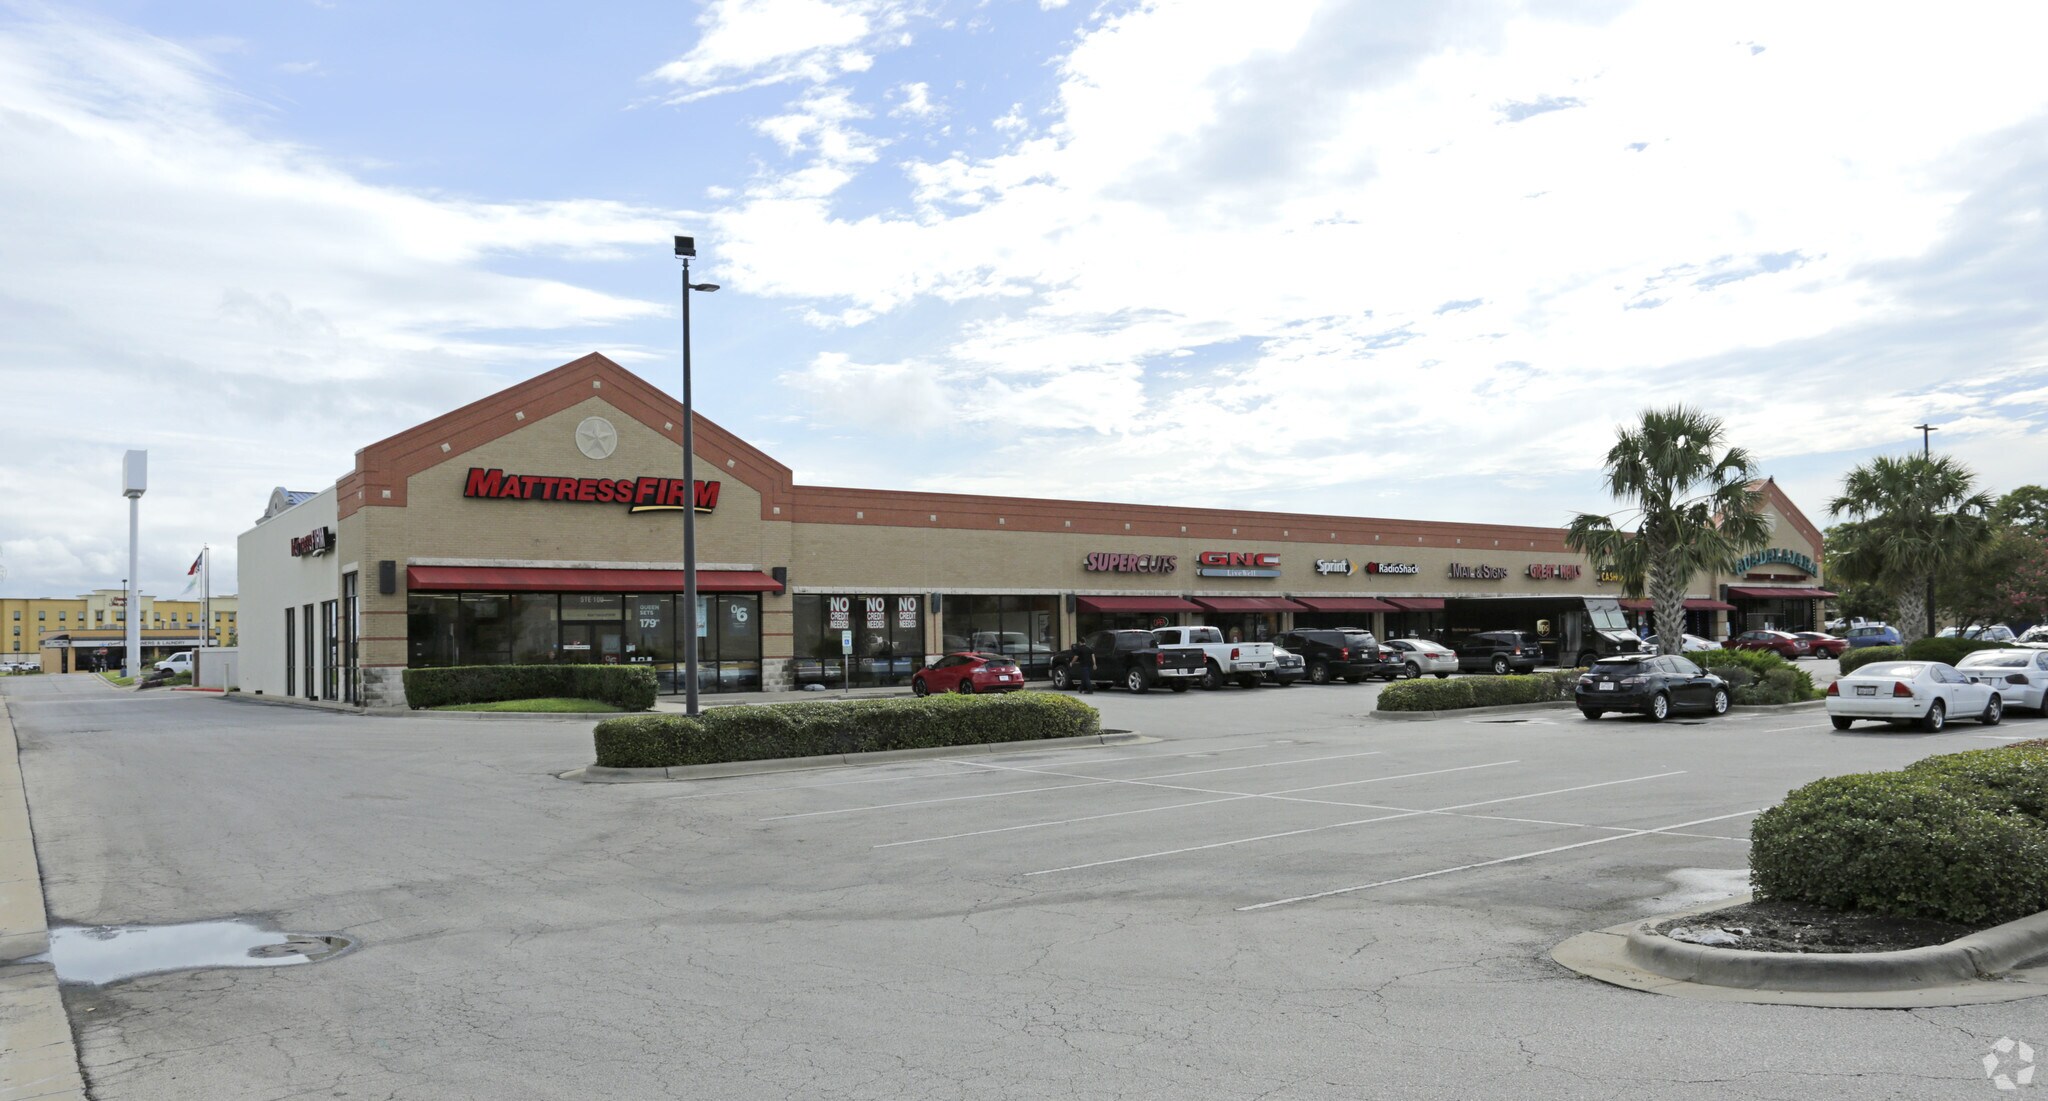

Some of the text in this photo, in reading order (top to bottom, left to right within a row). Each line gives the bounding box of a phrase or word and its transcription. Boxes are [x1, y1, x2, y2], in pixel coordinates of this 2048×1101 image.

[1087, 552, 1178, 575] SUPERCUTS
[1200, 551, 1281, 566] GNC
[1315, 559, 1348, 576] Sprint
[1378, 563, 1419, 574] RadioShack
[830, 597, 849, 611] NO
[866, 597, 884, 611] NO
[898, 597, 916, 611] NO
[830, 612, 849, 620] CREDIT
[867, 612, 884, 621] CREDIT
[899, 612, 916, 620] CREDIT
[830, 620, 849, 629] NEEDED
[866, 620, 884, 629] NEEDED
[899, 620, 916, 628] NEEDED
